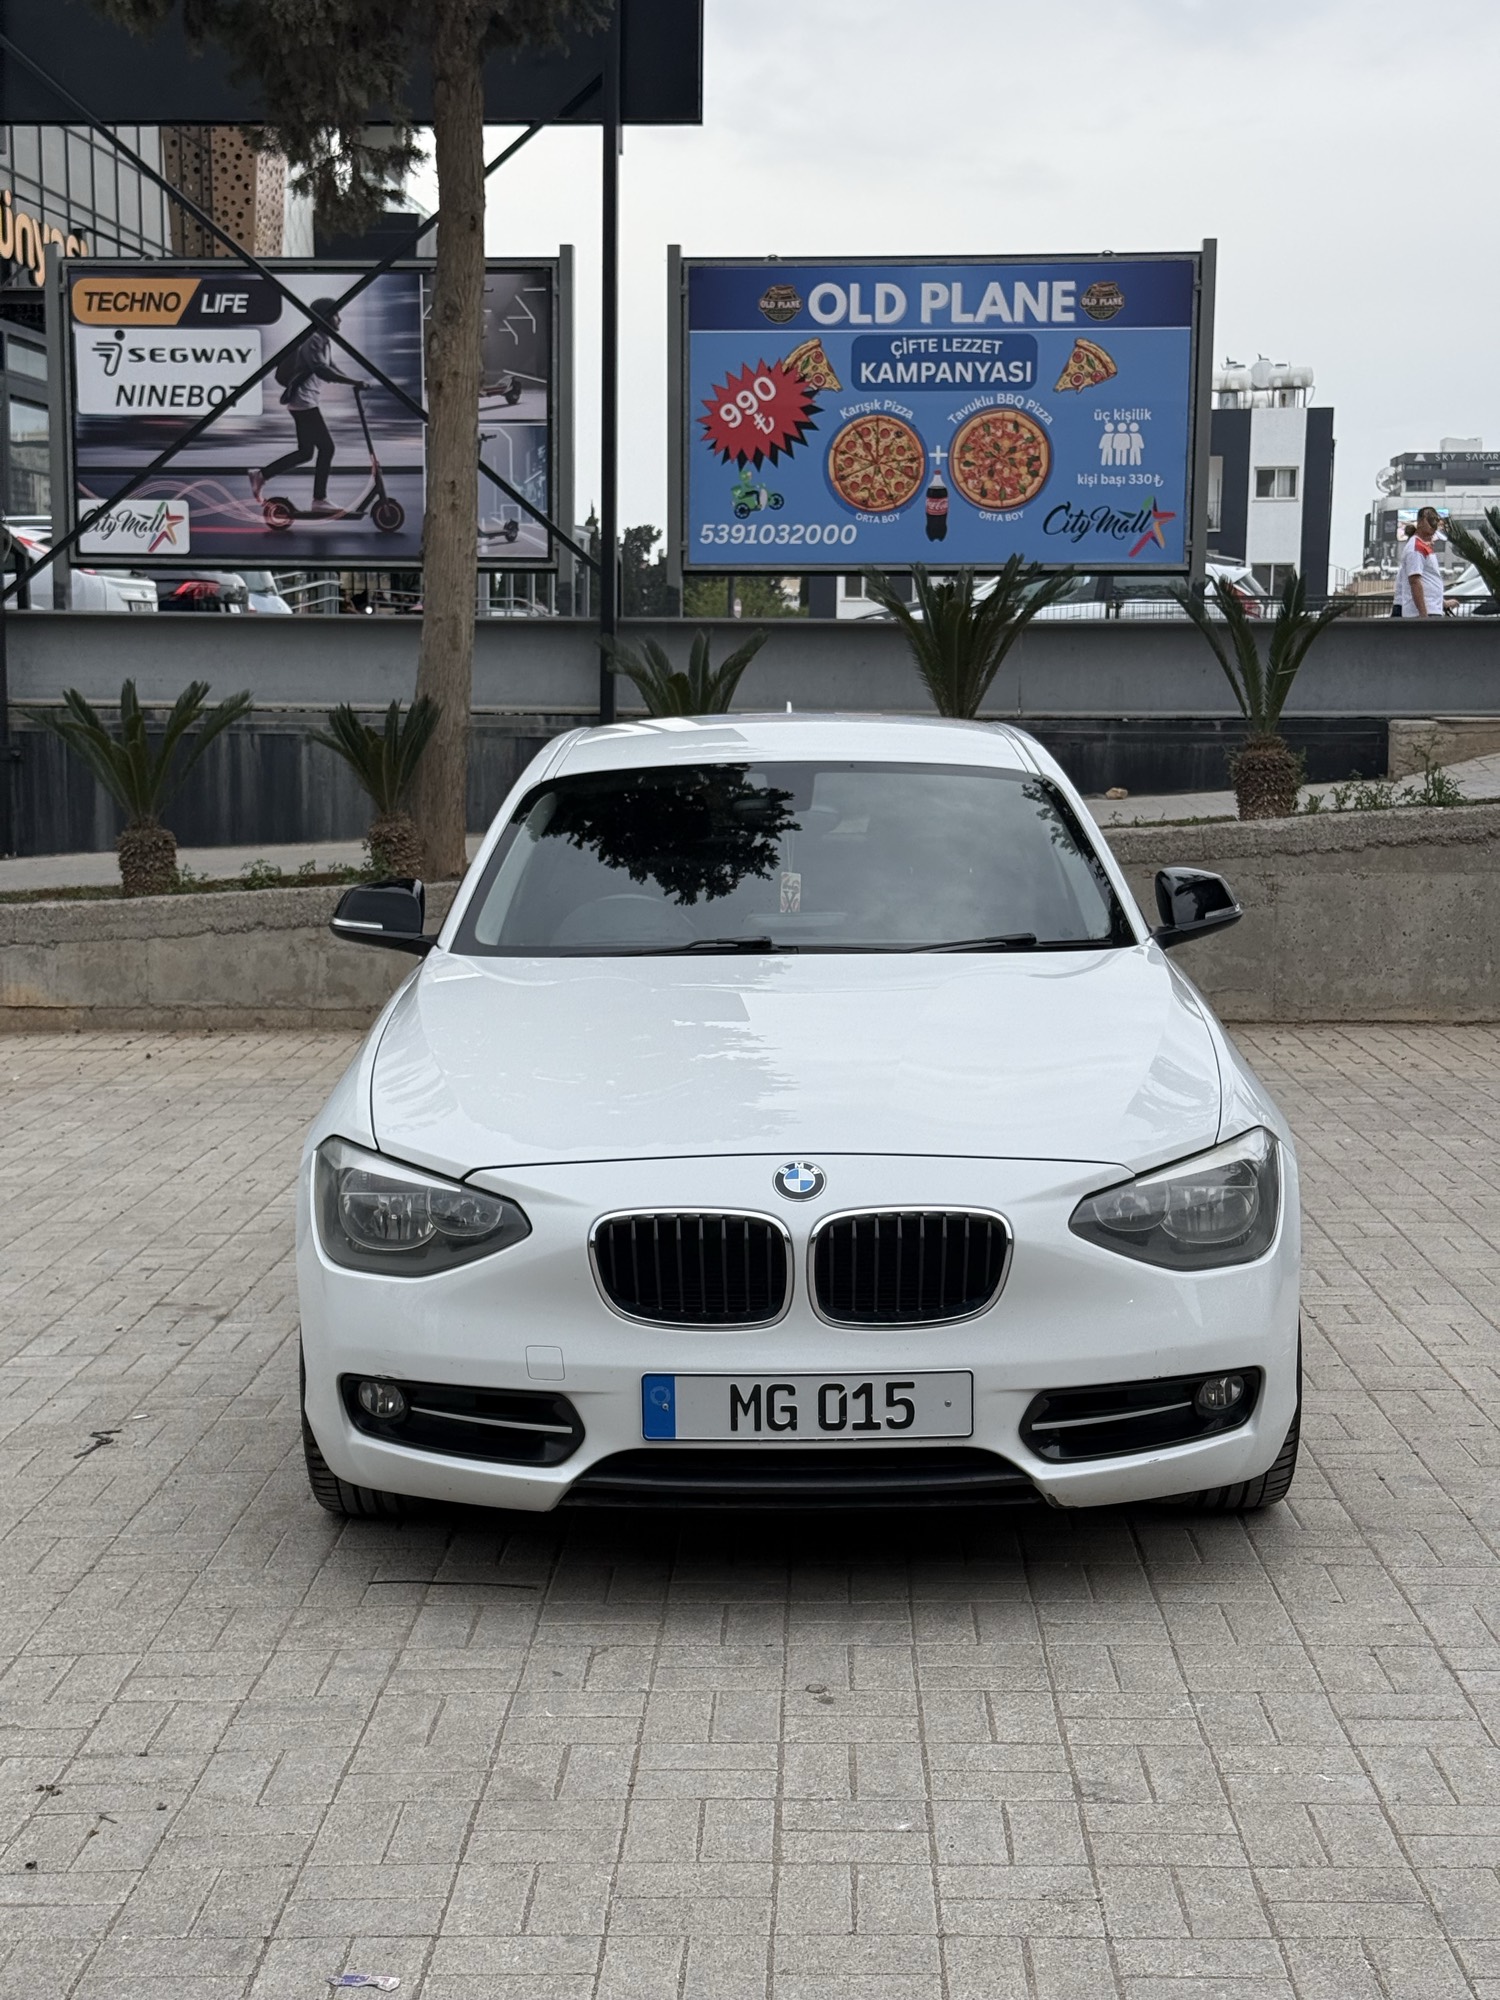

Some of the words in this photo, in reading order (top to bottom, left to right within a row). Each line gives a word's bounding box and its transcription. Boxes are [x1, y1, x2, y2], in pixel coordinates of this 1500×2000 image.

[84, 291, 181, 312] TECHNO
[201, 293, 249, 313] LIFE
[808, 282, 908, 326] OLD
[920, 281, 1077, 325] PLANE
[128, 347, 253, 364] SEGWAY
[890, 337, 938, 359] ÇİFTE
[942, 338, 1003, 355] LEZZET
[860, 361, 1032, 384] KAMPANYASI
[719, 376, 776, 428] 990
[839, 399, 881, 421] Karışık
[883, 400, 914, 420] Pizza
[947, 395, 994, 425] Tavuklu
[996, 393, 1025, 410] BBQ
[1028, 399, 1054, 426] Pizza
[1094, 408, 1110, 423] üç
[1113, 408, 1152, 423] kişilik
[1435, 453, 1456, 462] SKY
[1077, 474, 1097, 487] kişi
[1100, 474, 1126, 487] başı
[855, 512, 880, 524] ORTA
[881, 512, 901, 524] BOY
[978, 511, 1003, 522] ORTA
[1005, 511, 1024, 522] BOY
[699, 524, 858, 545] 5391032000
[730, 1383, 798, 1432] MG
[818, 1381, 915, 1431] 015
